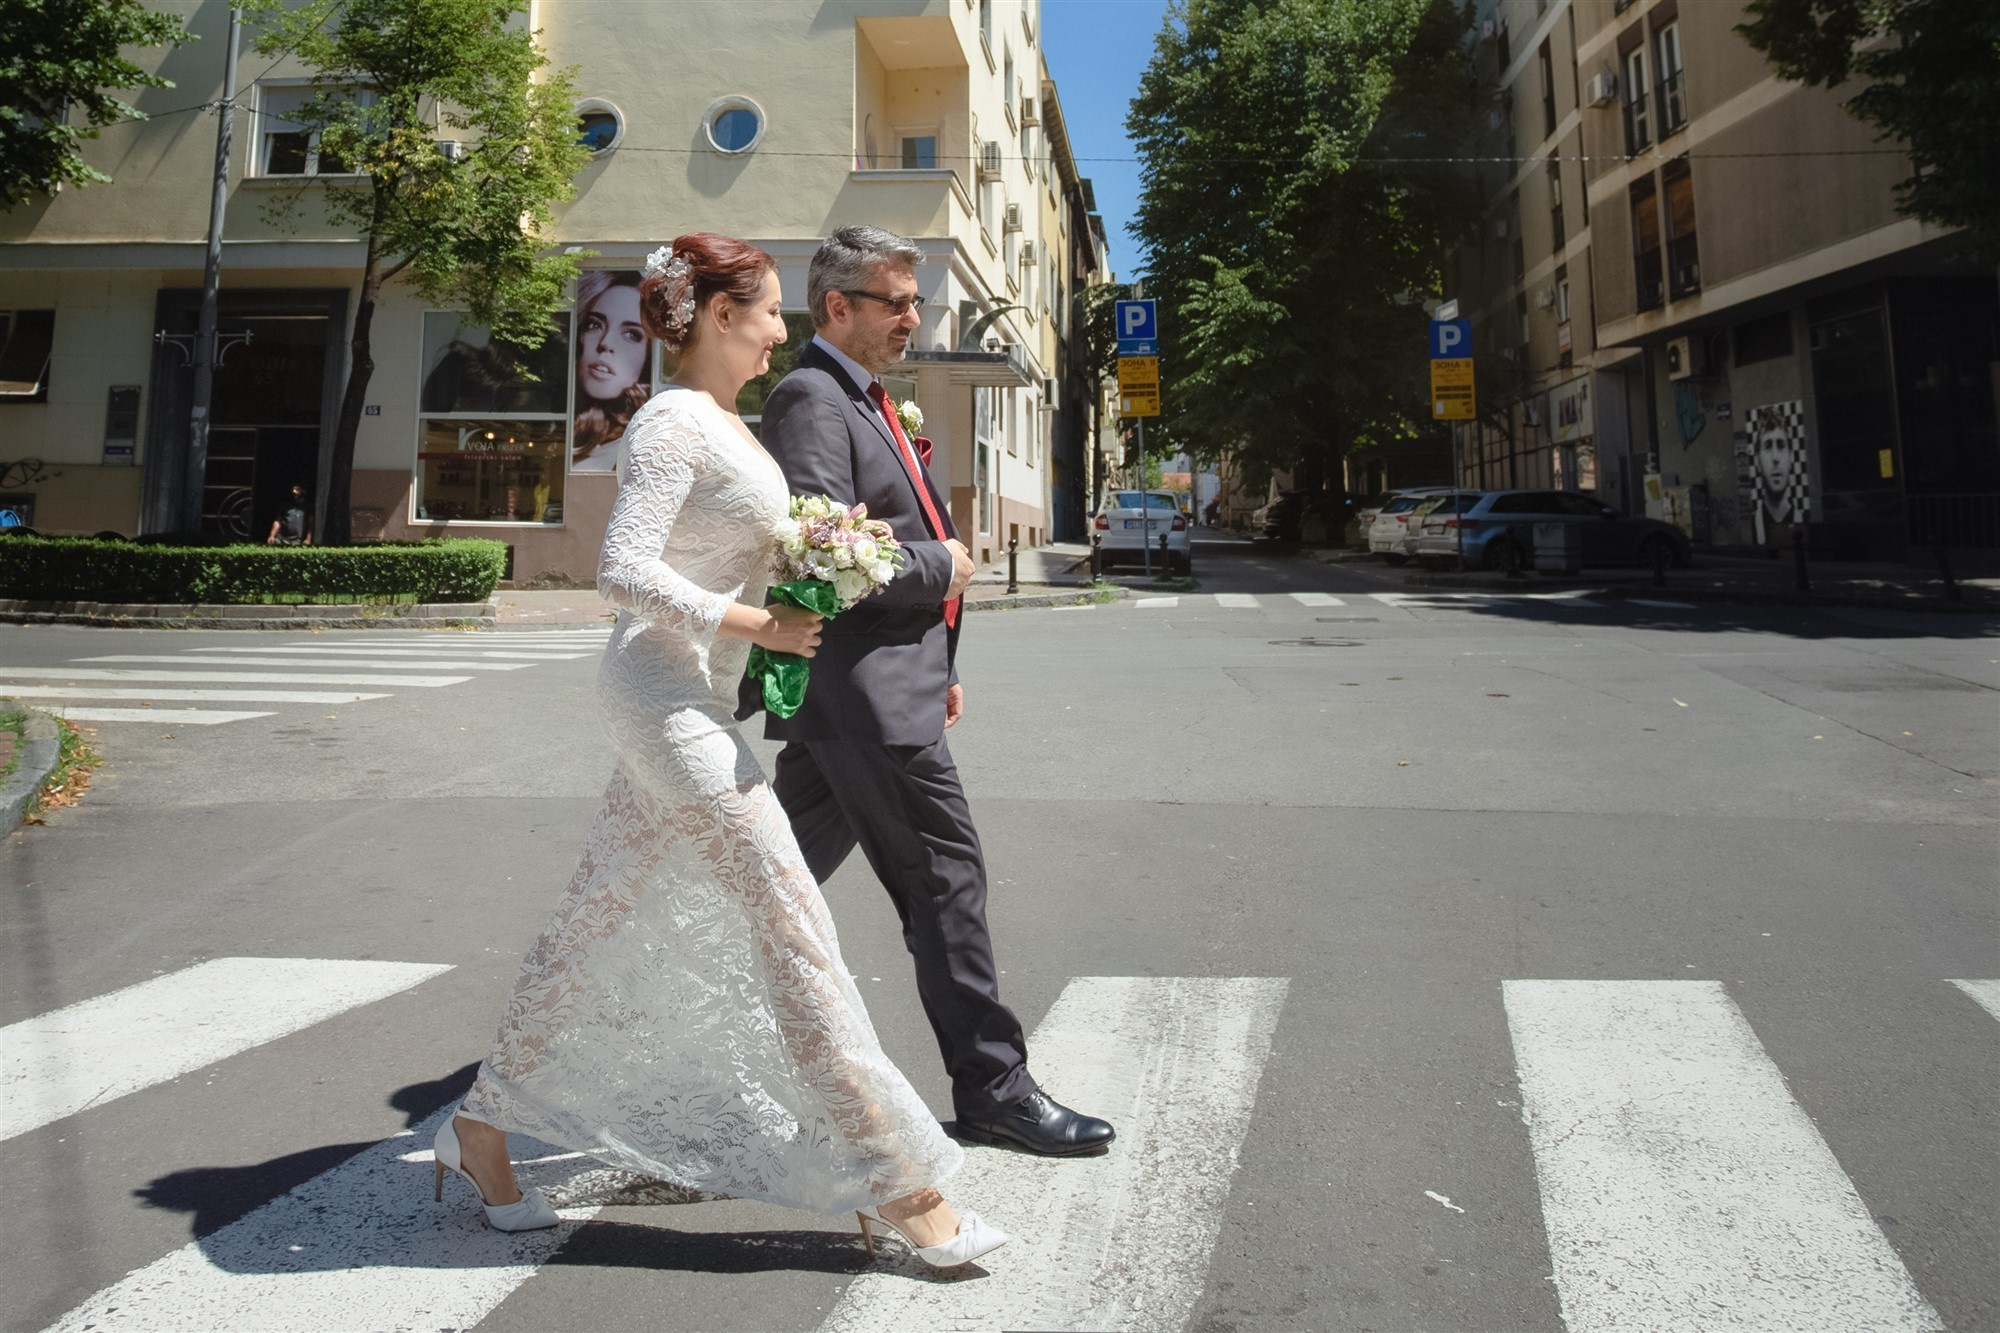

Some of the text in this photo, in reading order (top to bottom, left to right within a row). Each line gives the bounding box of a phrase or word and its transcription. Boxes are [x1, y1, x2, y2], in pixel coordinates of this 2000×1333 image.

[1124, 305, 1147, 336] P
[1438, 325, 1462, 354] P
[1121, 359, 1146, 368] ЗОНА
[467, 441, 525, 452] VOJA FRIZER
